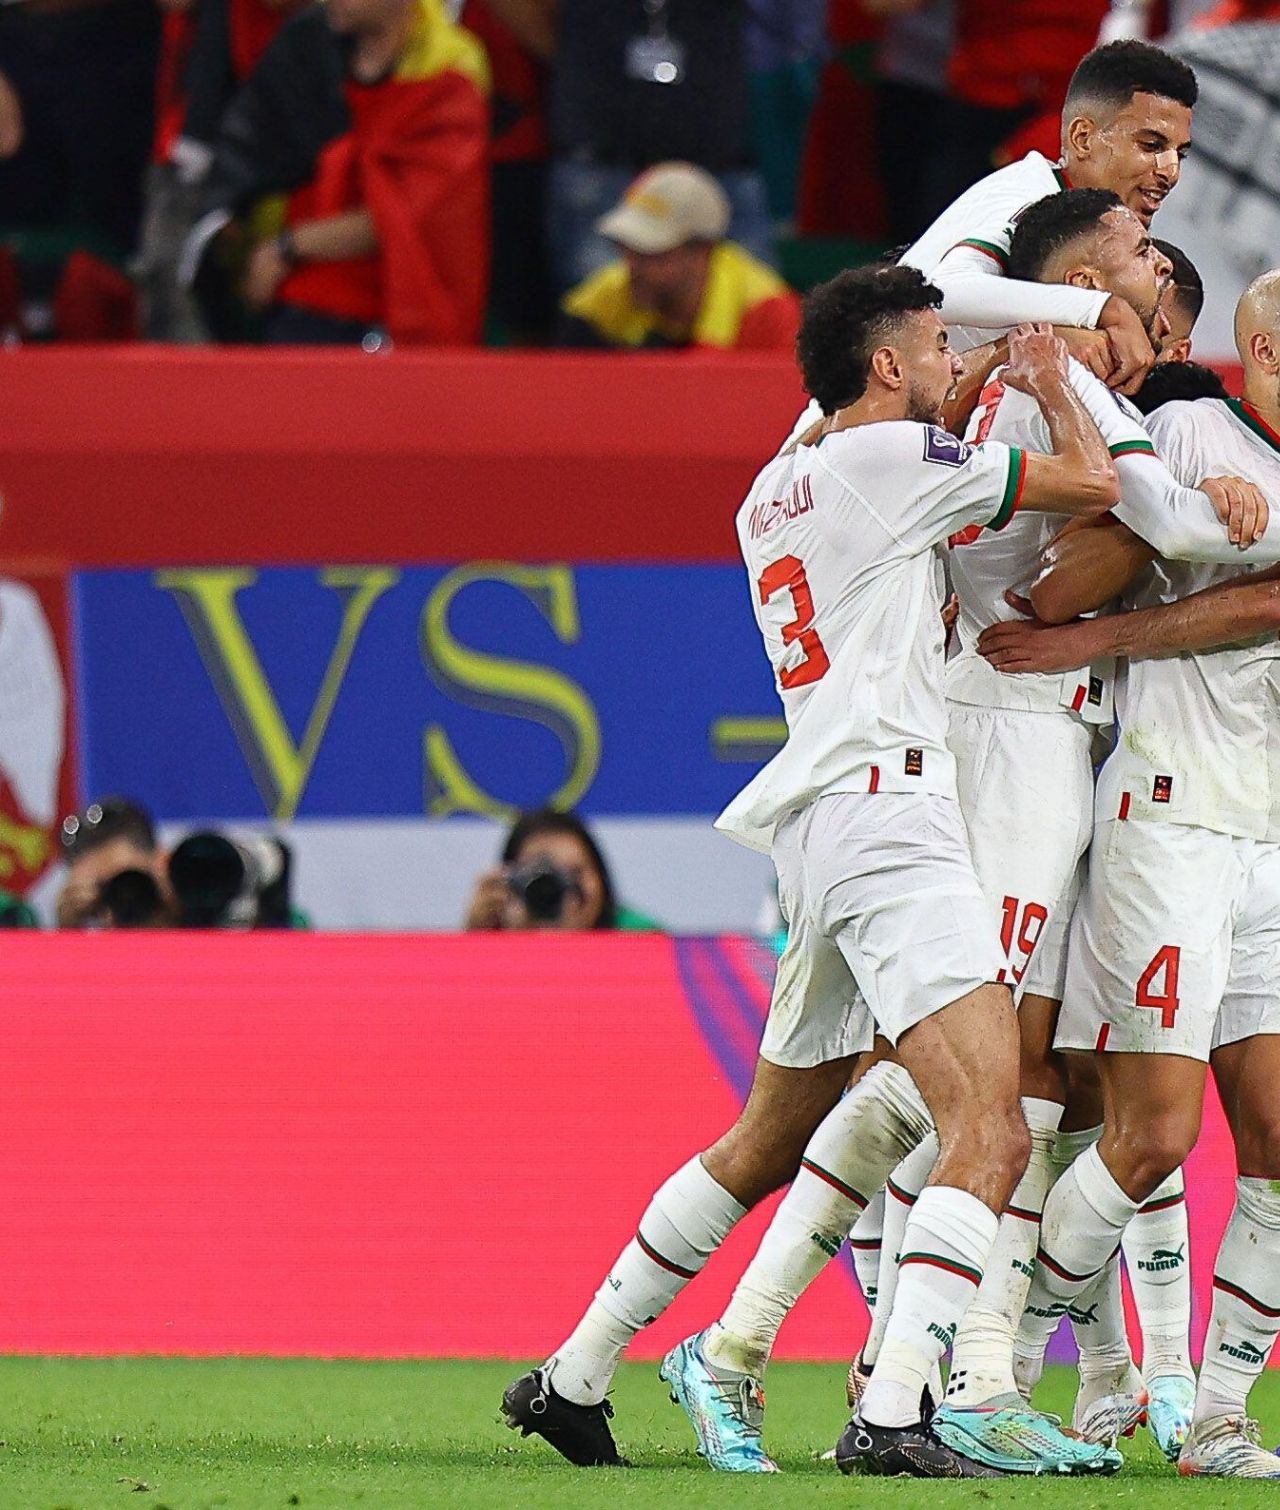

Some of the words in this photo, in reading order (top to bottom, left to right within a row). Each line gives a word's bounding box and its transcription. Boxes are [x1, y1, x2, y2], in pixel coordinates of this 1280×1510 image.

[758, 554, 831, 690] 3
[156, 561, 600, 820] VS
[999, 895, 1048, 985] 19
[1136, 945, 1182, 1029] 4
[1137, 1257, 1179, 1271] PUMA
[1219, 1343, 1260, 1364] PUMA
